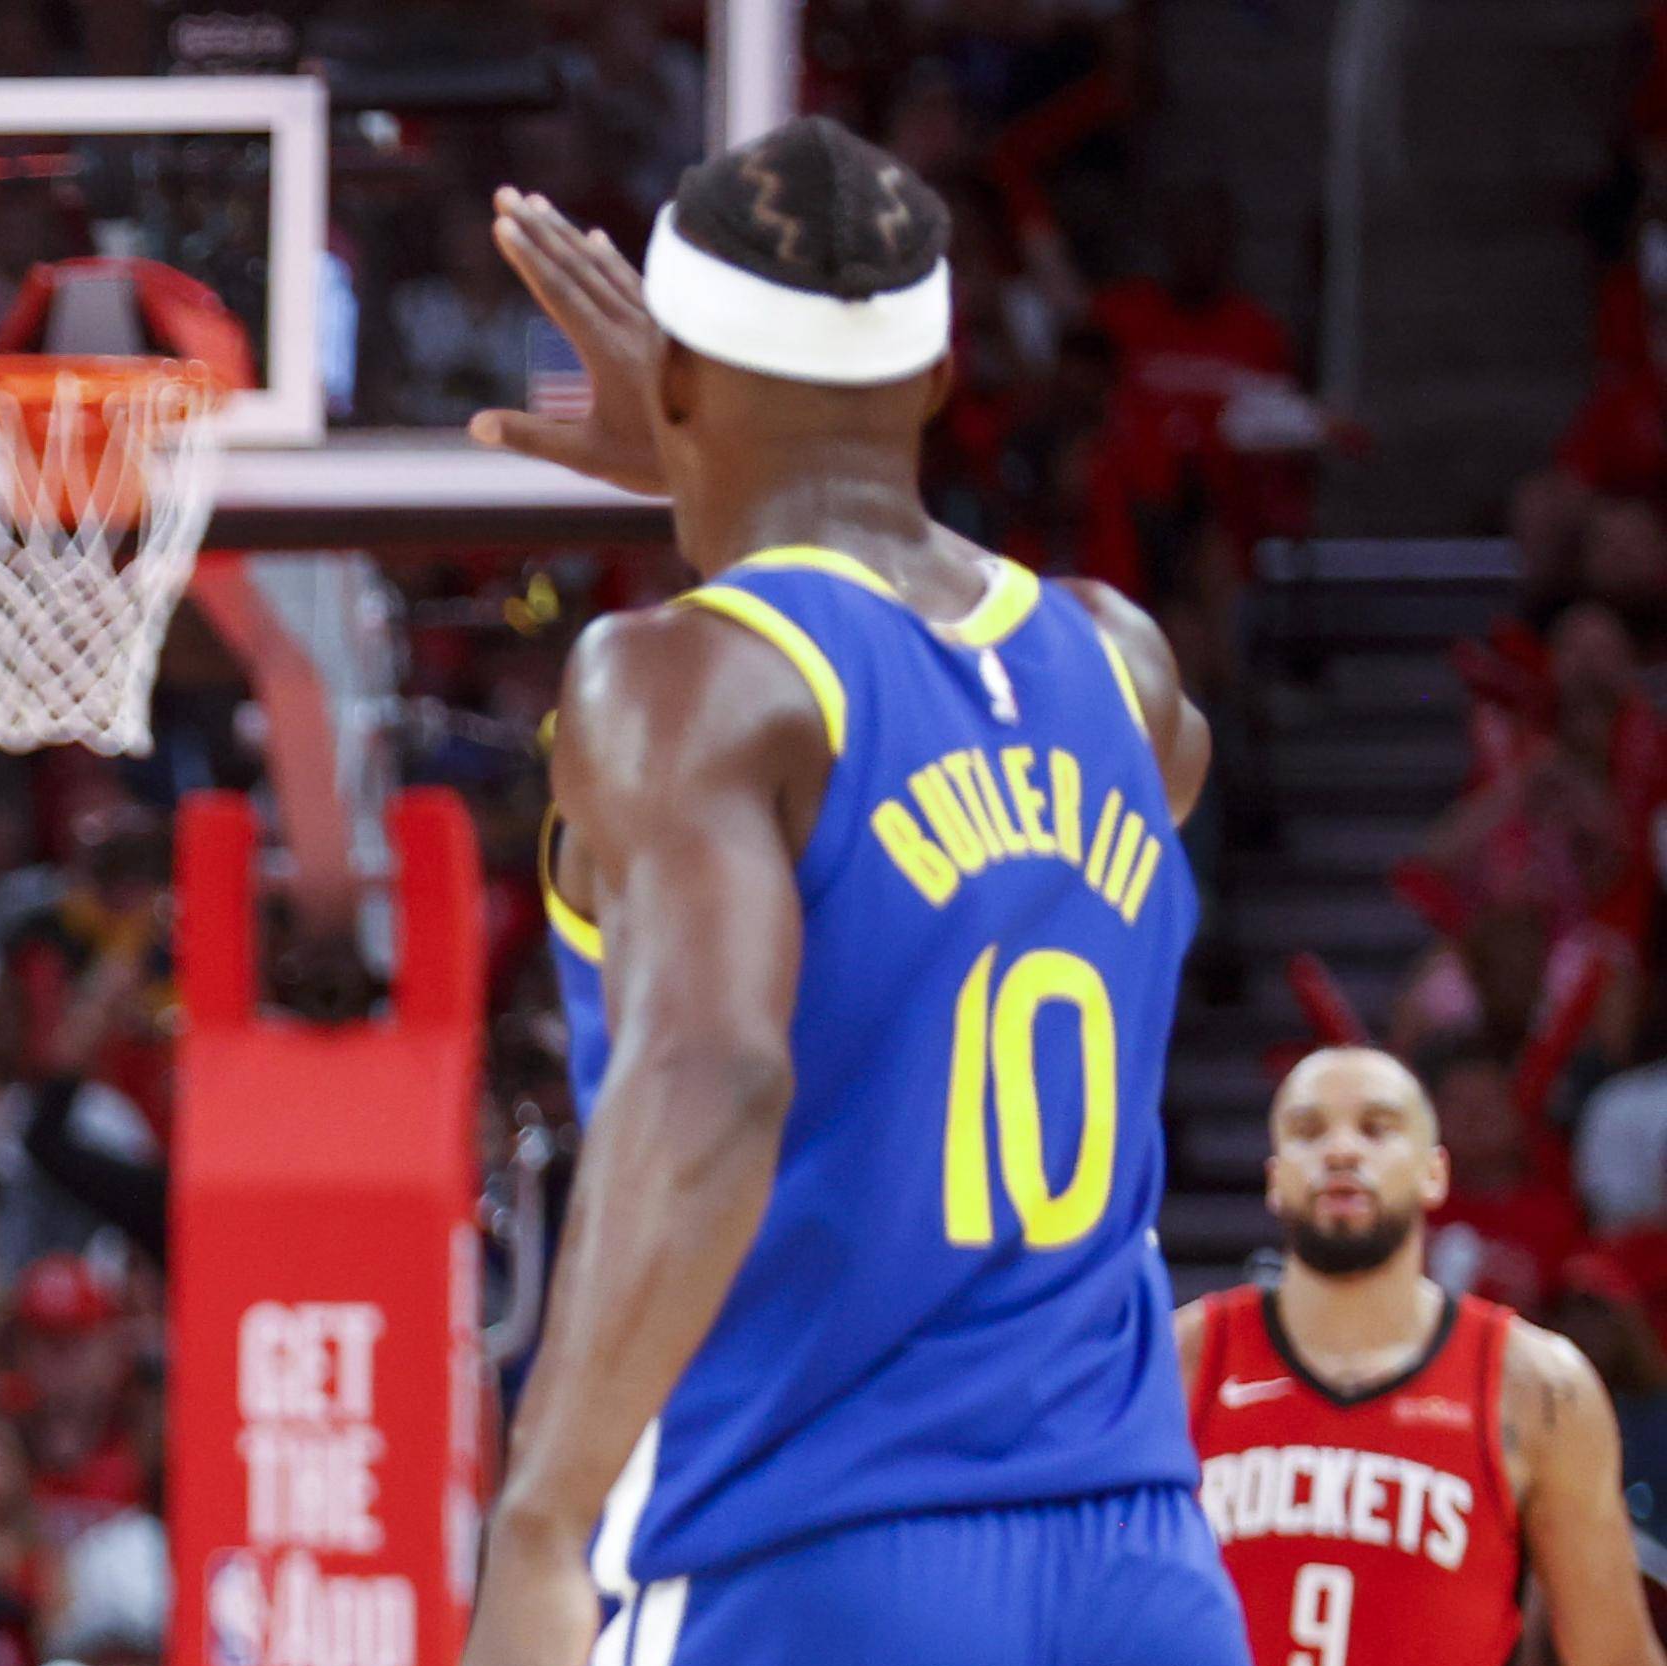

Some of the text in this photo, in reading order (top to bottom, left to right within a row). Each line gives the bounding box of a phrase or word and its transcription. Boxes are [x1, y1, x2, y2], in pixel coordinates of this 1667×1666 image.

[871, 745, 1162, 925] BUTLER III
[943, 943, 1117, 1248] 10
[238, 1301, 385, 1422] GET
[237, 1424, 385, 1554] THE
[1199, 1444, 1473, 1571] ROCKETS
